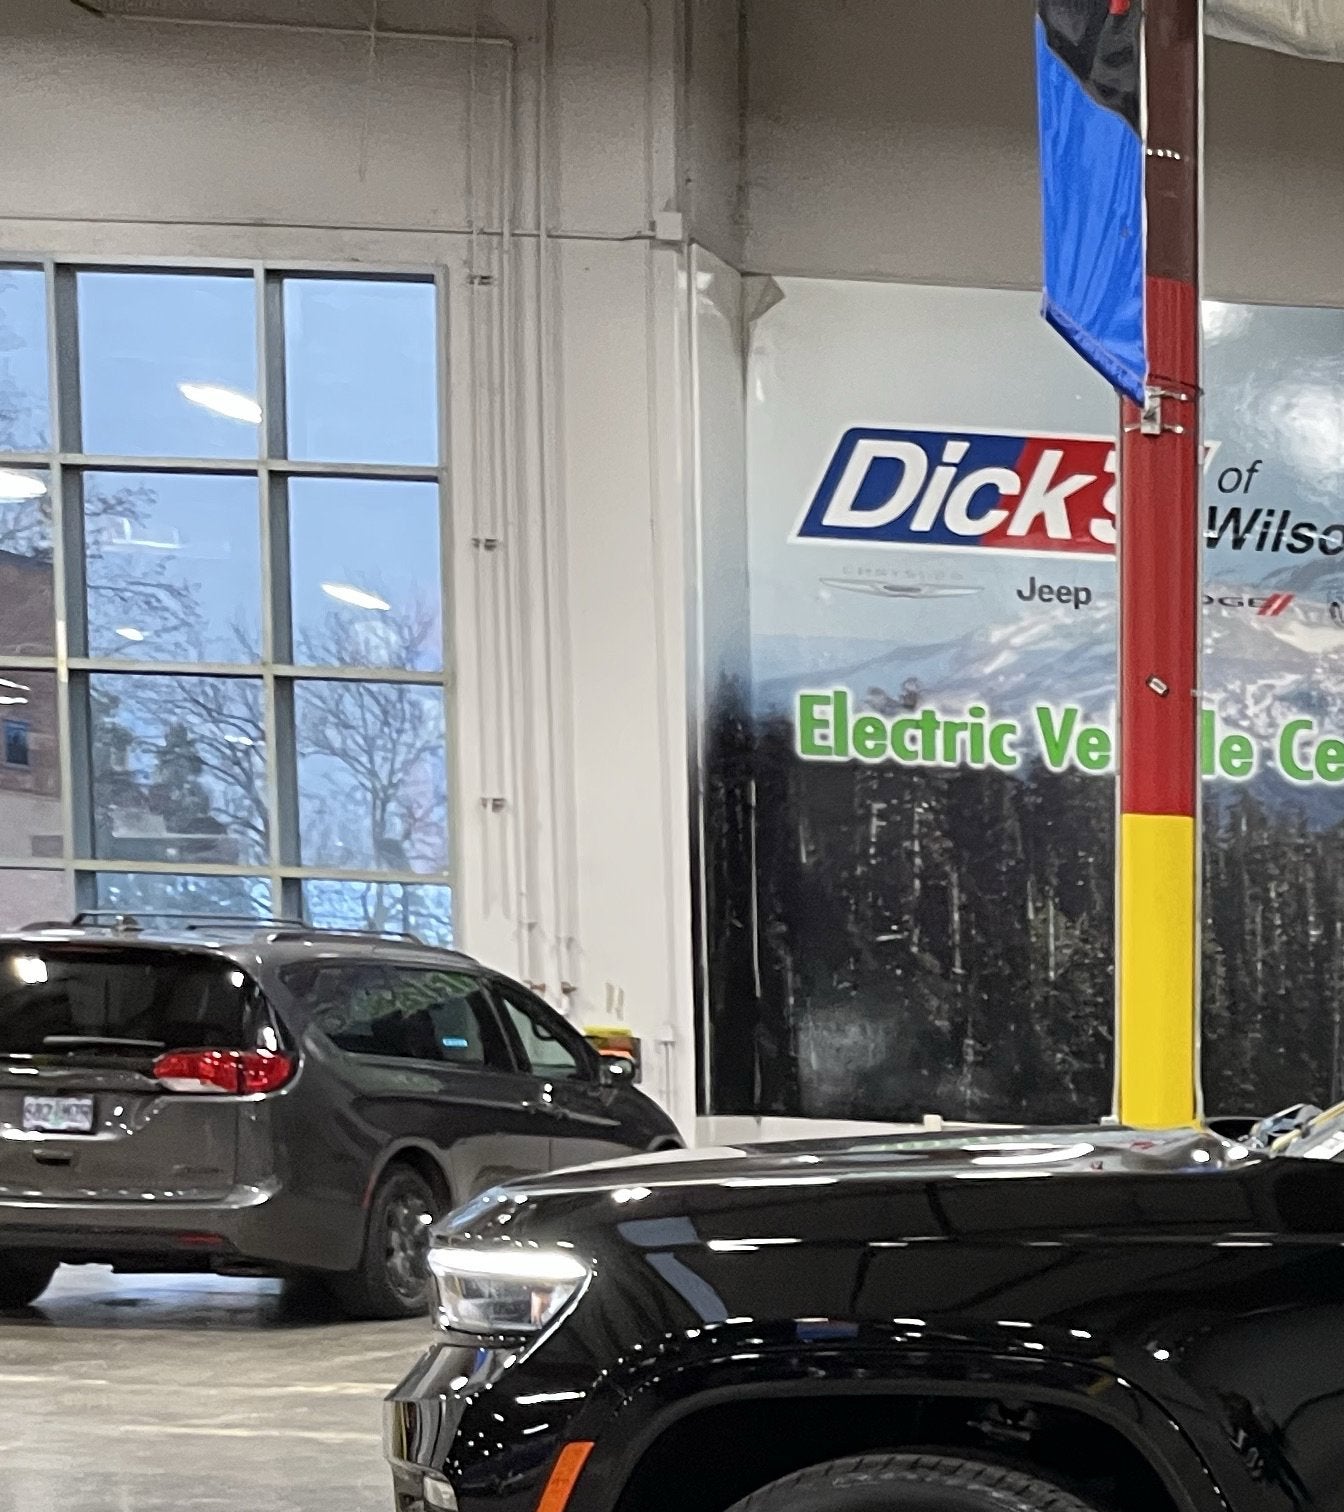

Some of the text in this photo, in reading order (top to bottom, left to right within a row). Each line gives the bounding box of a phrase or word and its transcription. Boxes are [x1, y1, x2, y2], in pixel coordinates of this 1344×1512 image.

[1217, 459, 1263, 494] of
[1016, 576, 1092, 610] Jeep
[800, 691, 1017, 766] Electric
[1036, 706, 1253, 777] Vele
